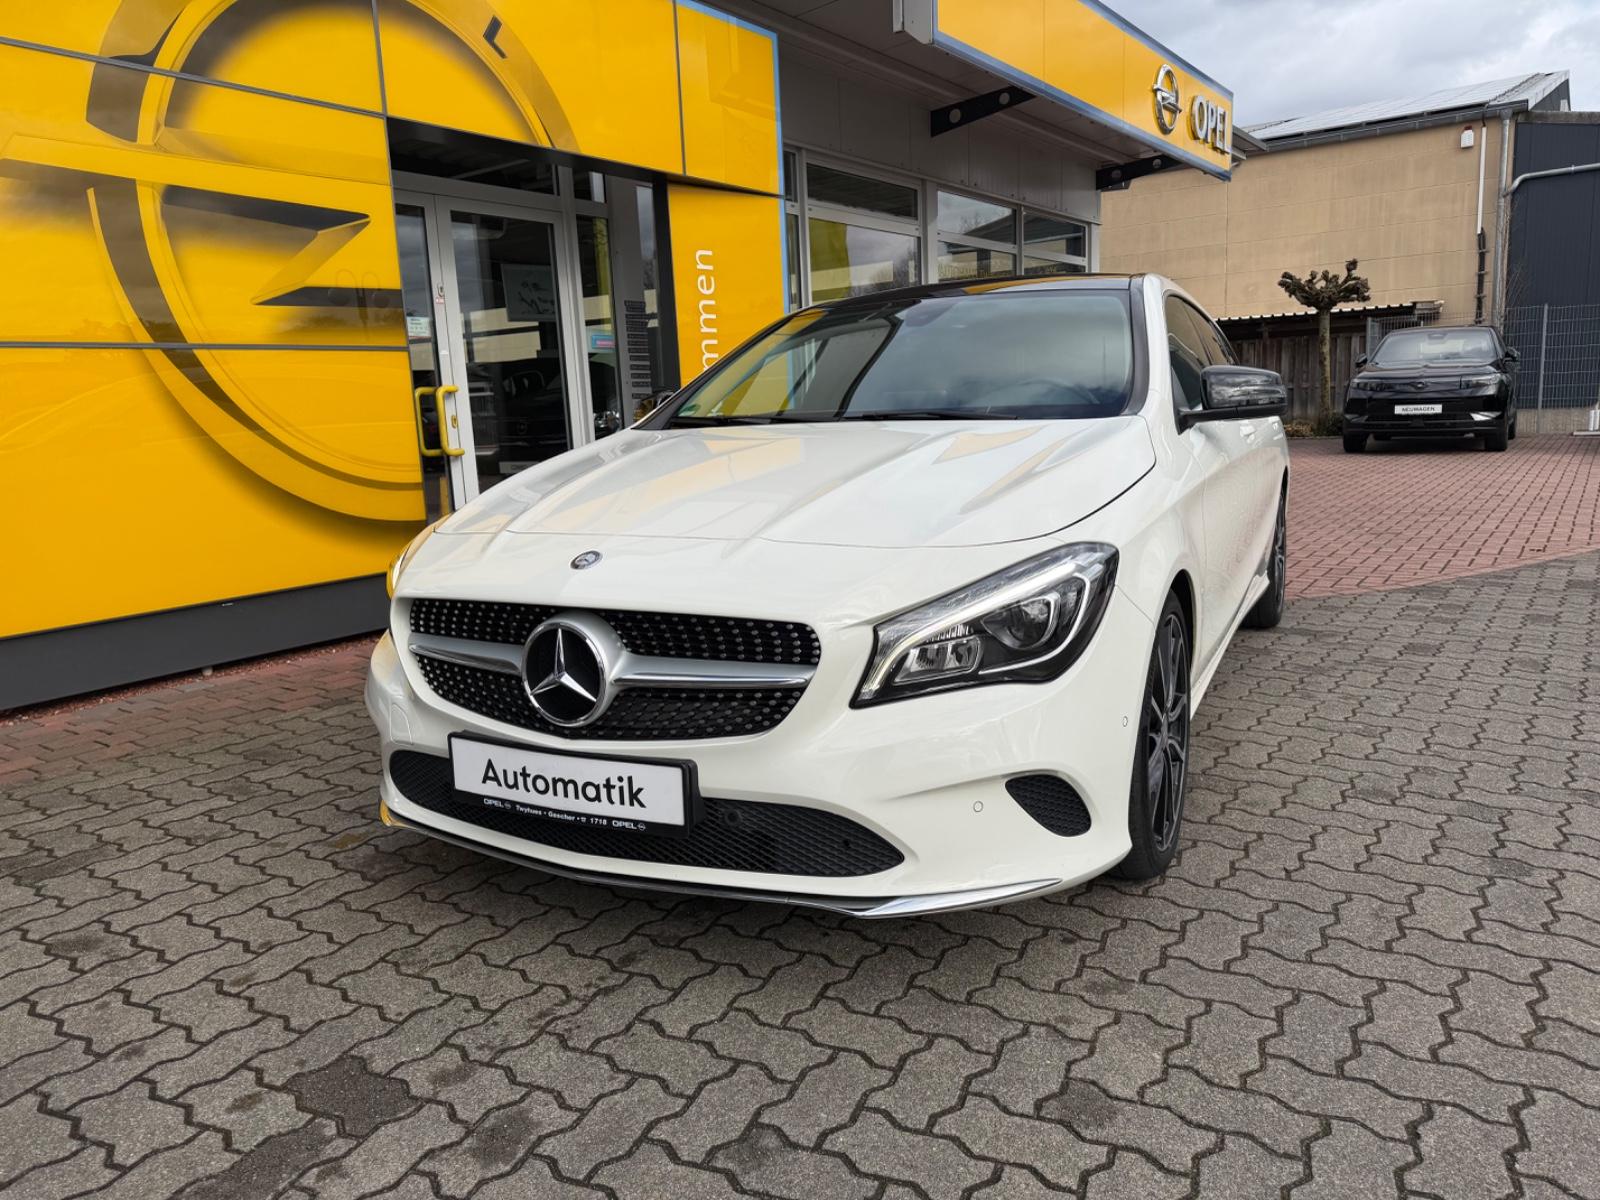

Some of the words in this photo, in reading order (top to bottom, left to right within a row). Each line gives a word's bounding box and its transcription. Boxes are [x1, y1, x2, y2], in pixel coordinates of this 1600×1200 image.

[1191, 95, 1231, 153] OPEL
[481, 758, 647, 809] Automatik
[484, 798, 504, 809] OPEL
[612, 820, 637, 830] OPEL
